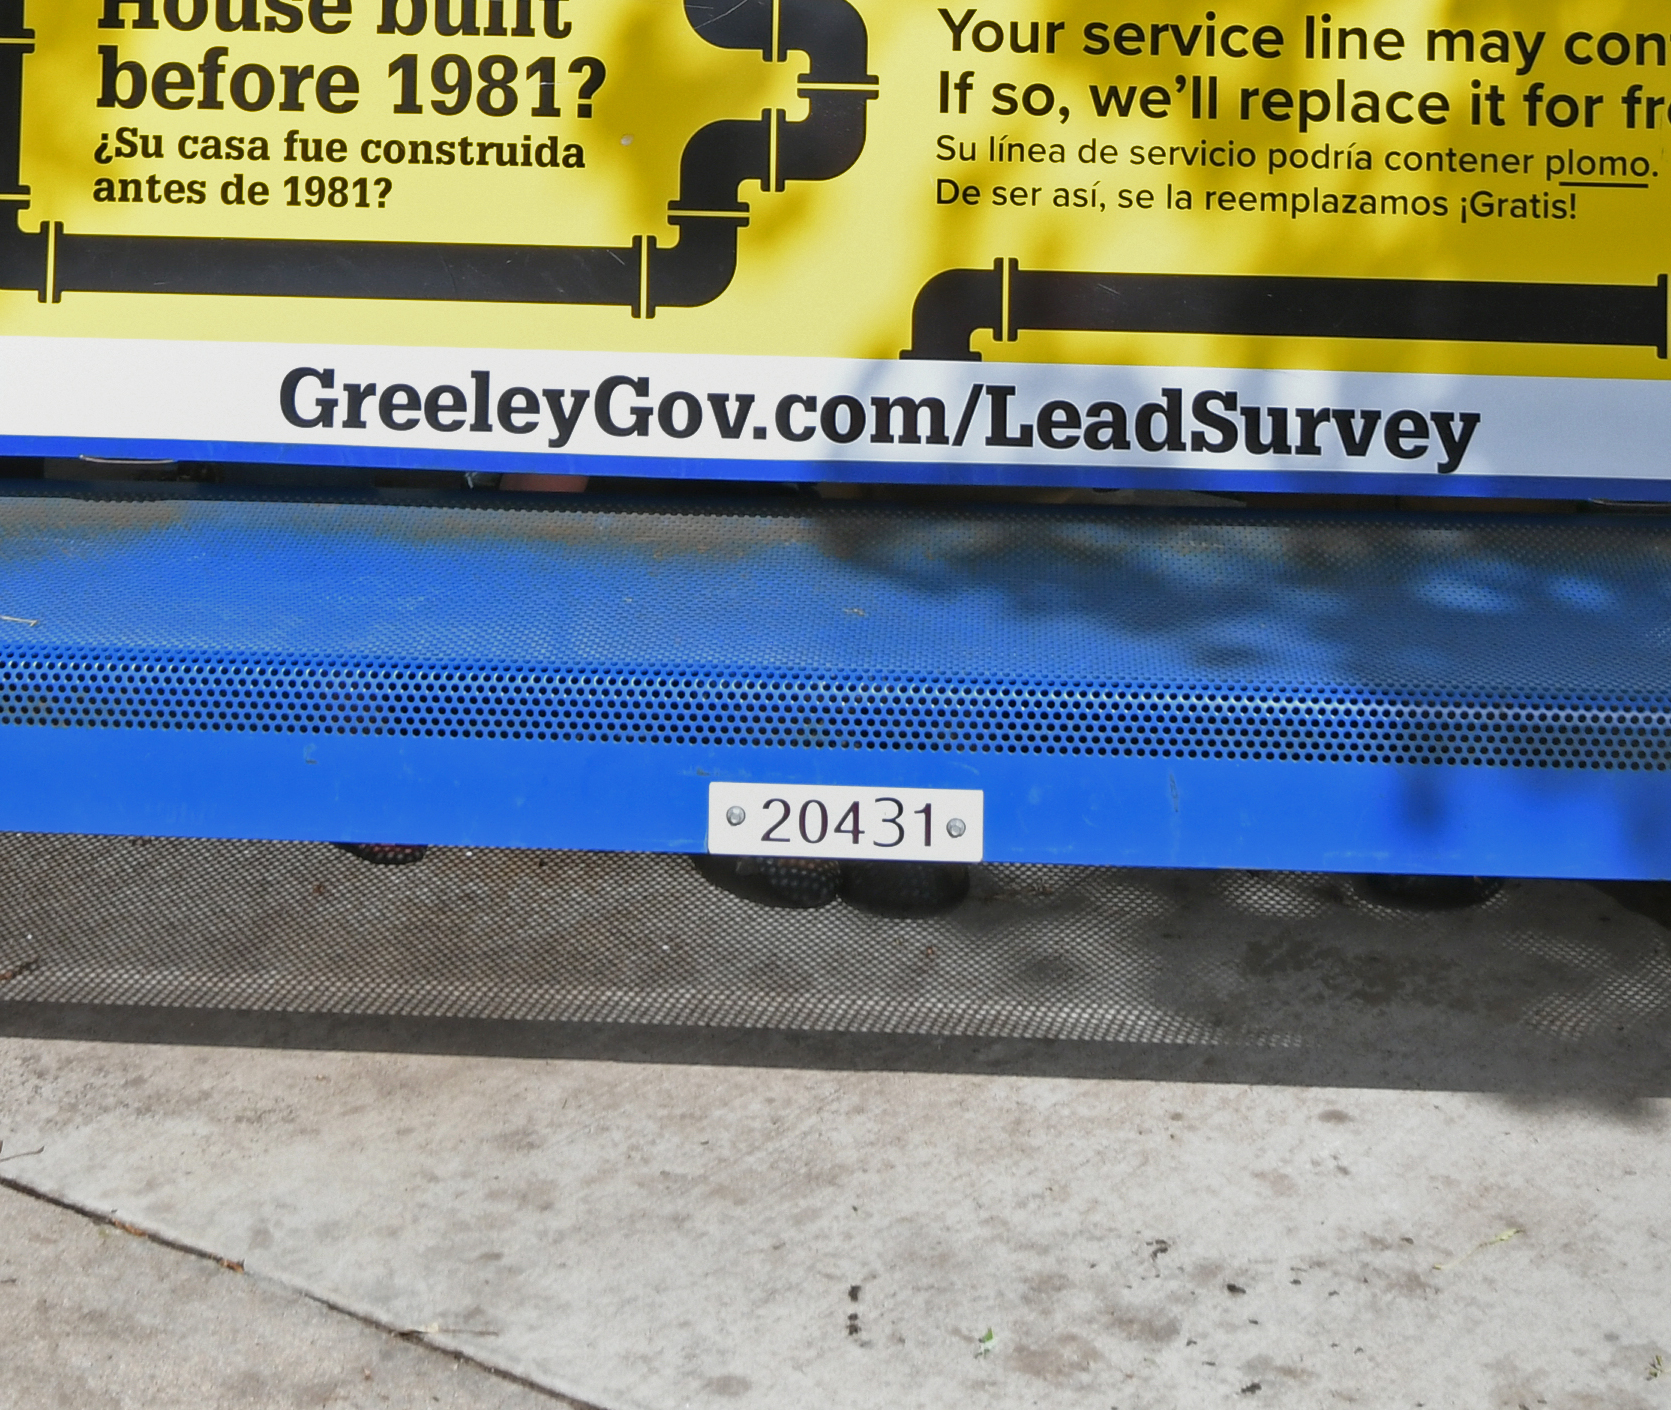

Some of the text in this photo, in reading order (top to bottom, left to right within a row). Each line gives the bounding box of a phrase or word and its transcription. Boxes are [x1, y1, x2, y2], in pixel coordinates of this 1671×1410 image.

[937, 8, 1065, 53] Your
[1082, 11, 1283, 58] service
[1305, 13, 1403, 60] line
[1427, 28, 1546, 75] may
[96, 45, 606, 118] before 1981?
[939, 71, 974, 113] If
[991, 83, 1068, 124] so,
[1240, 78, 1449, 132] replace
[1471, 79, 1505, 126] it
[1522, 82, 1603, 127] for
[93, 127, 584, 167] ¿Su casa fue construida
[92, 173, 392, 207] antes de 1981?
[278, 367, 1481, 474] GreeleyGov.com/LeadSurvey
[761, 798, 933, 847] 20431
